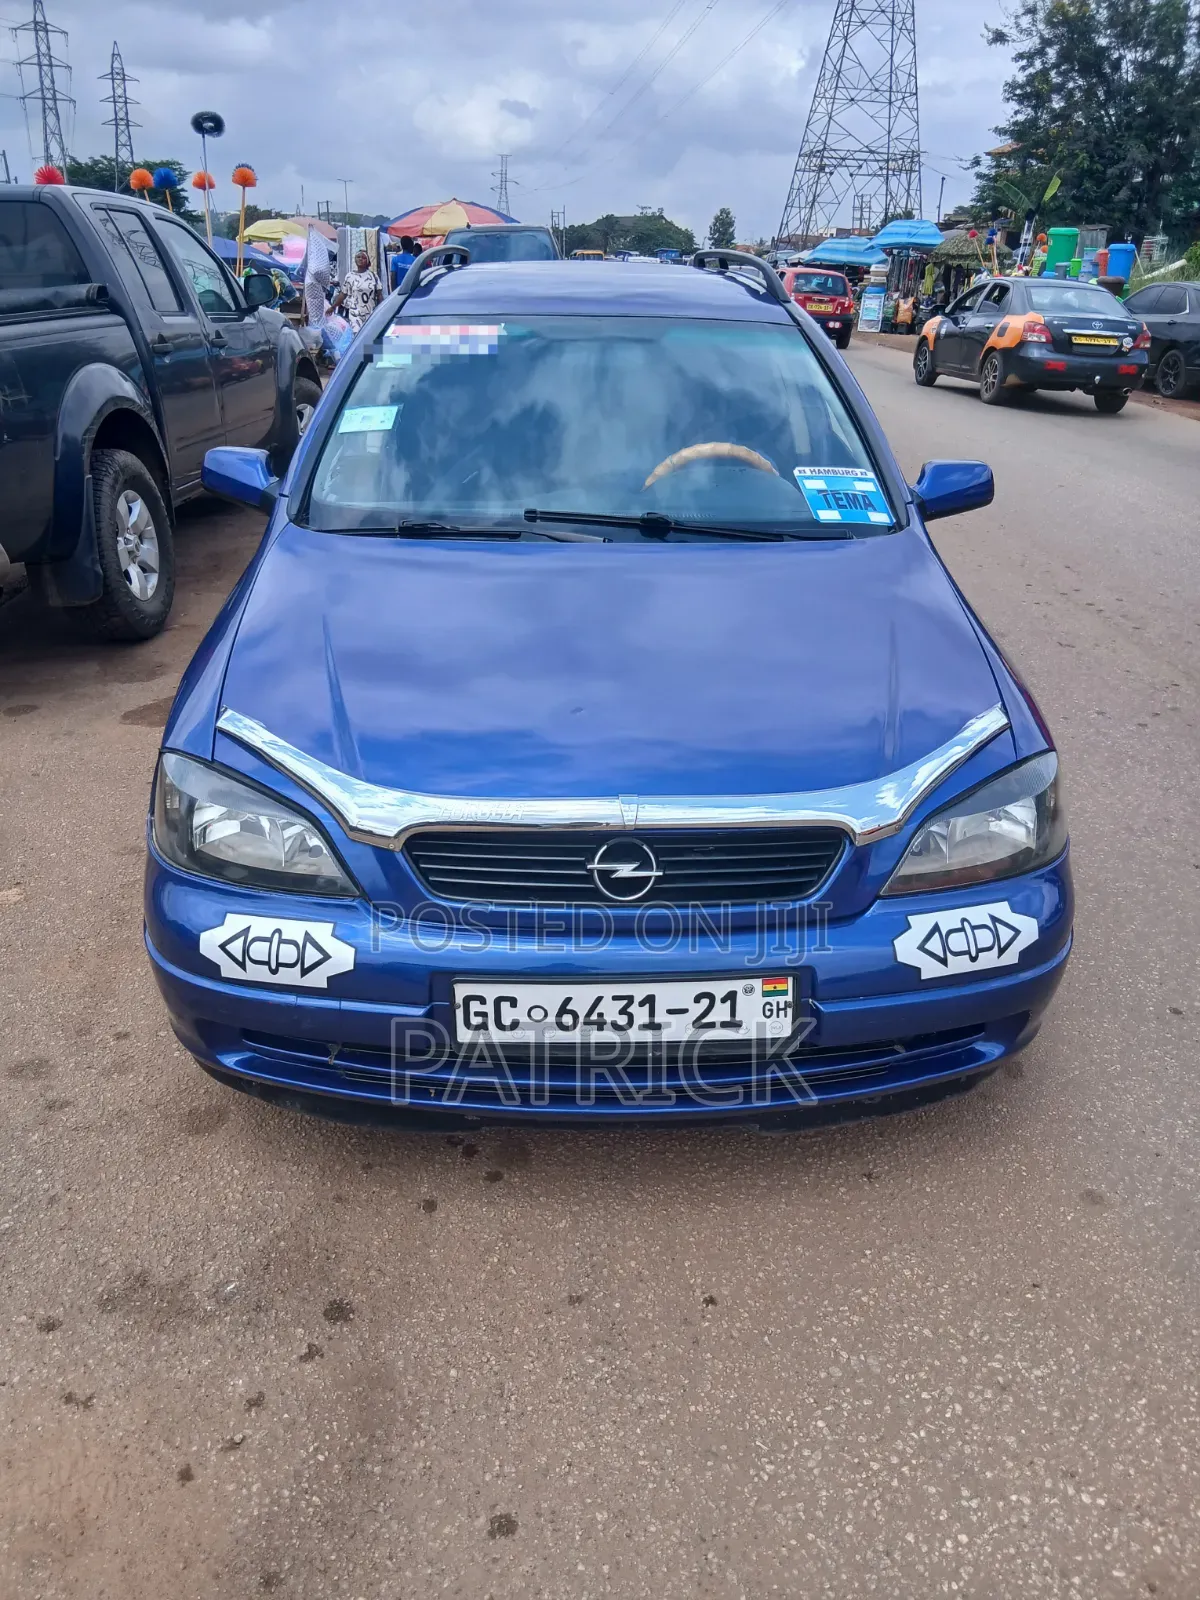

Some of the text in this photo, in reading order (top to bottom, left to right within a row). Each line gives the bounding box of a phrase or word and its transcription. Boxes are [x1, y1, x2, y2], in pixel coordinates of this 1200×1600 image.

[809, 468, 858, 476] HAMBURG
[817, 490, 877, 511] TEMA
[462, 994, 520, 1032] GC
[762, 1001, 788, 1019] GH
